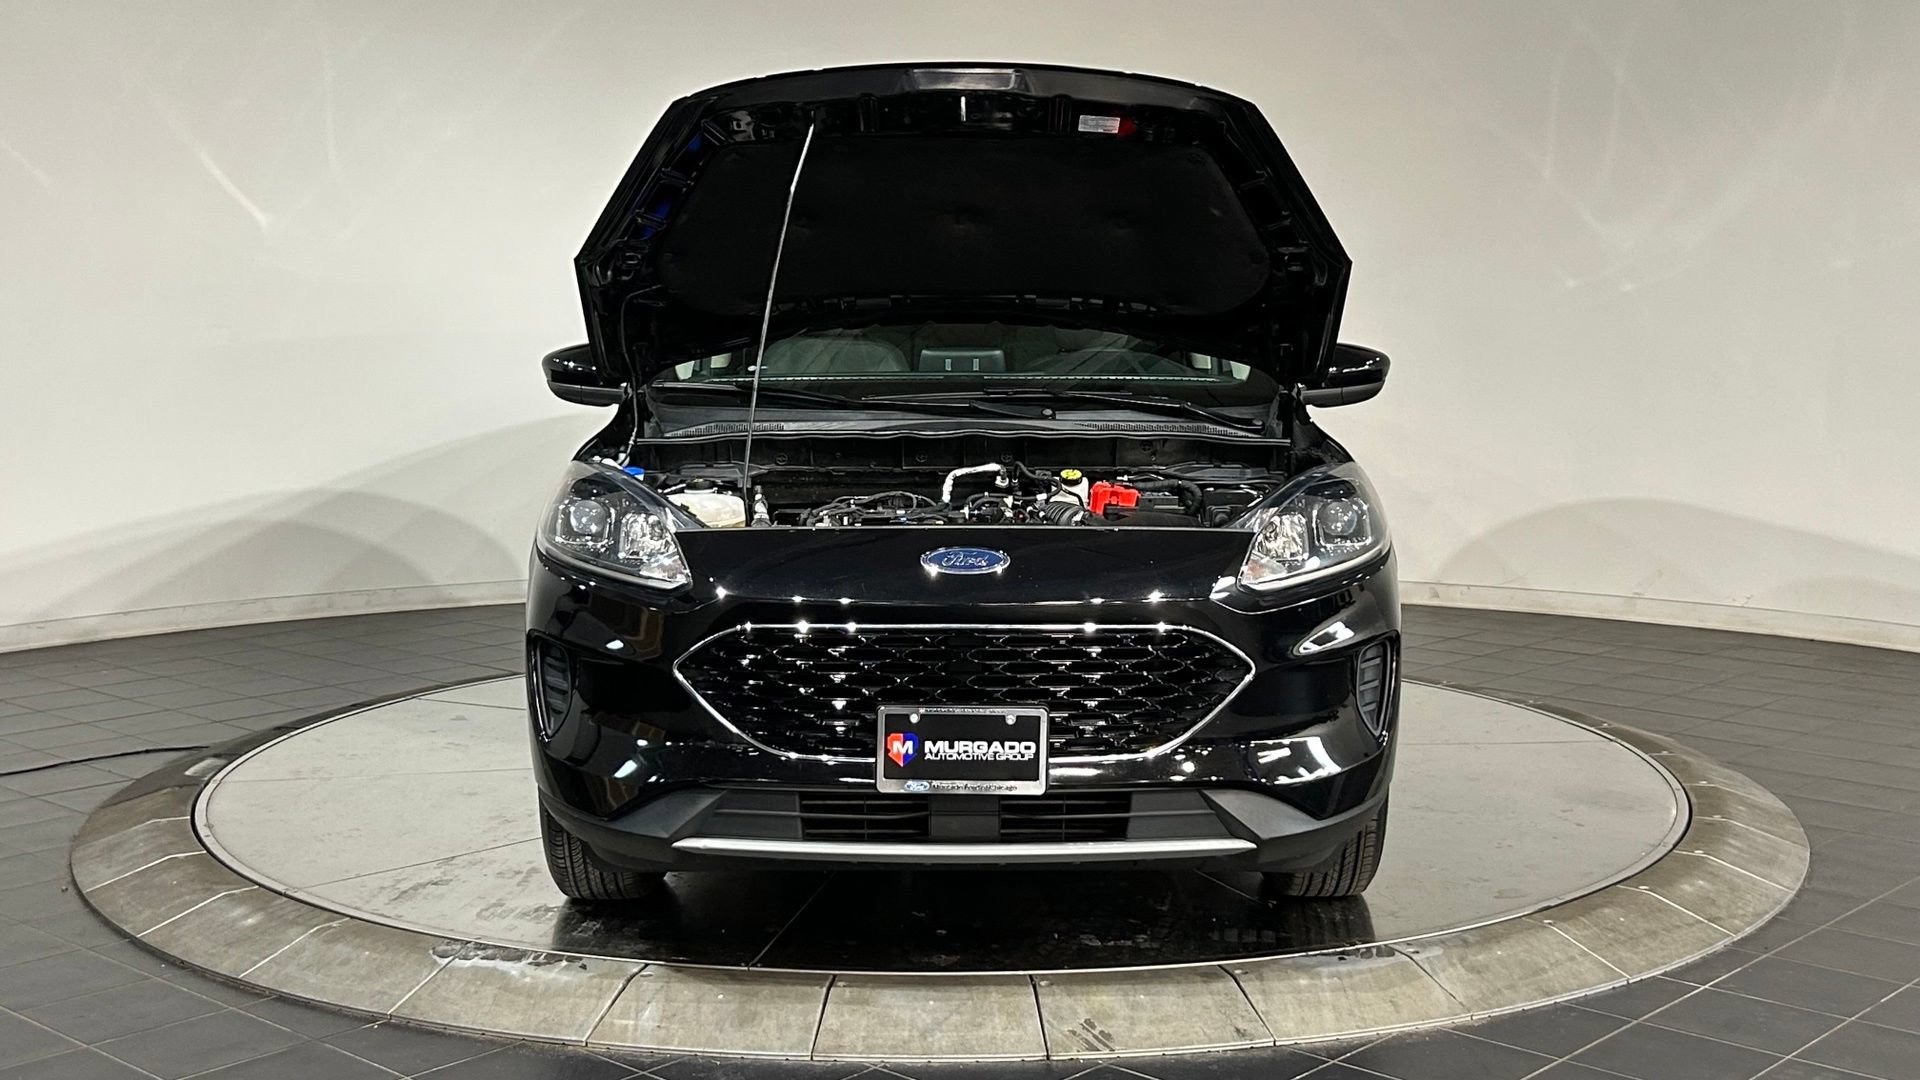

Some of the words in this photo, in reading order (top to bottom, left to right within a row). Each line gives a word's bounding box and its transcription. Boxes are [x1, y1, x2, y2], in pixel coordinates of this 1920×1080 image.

[941, 551, 989, 567] Ford
[892, 740, 914, 755] M
[924, 740, 1037, 754] MURGADO
[924, 753, 995, 761] AUTOMOTIVE
[995, 753, 1035, 761] GROUP
